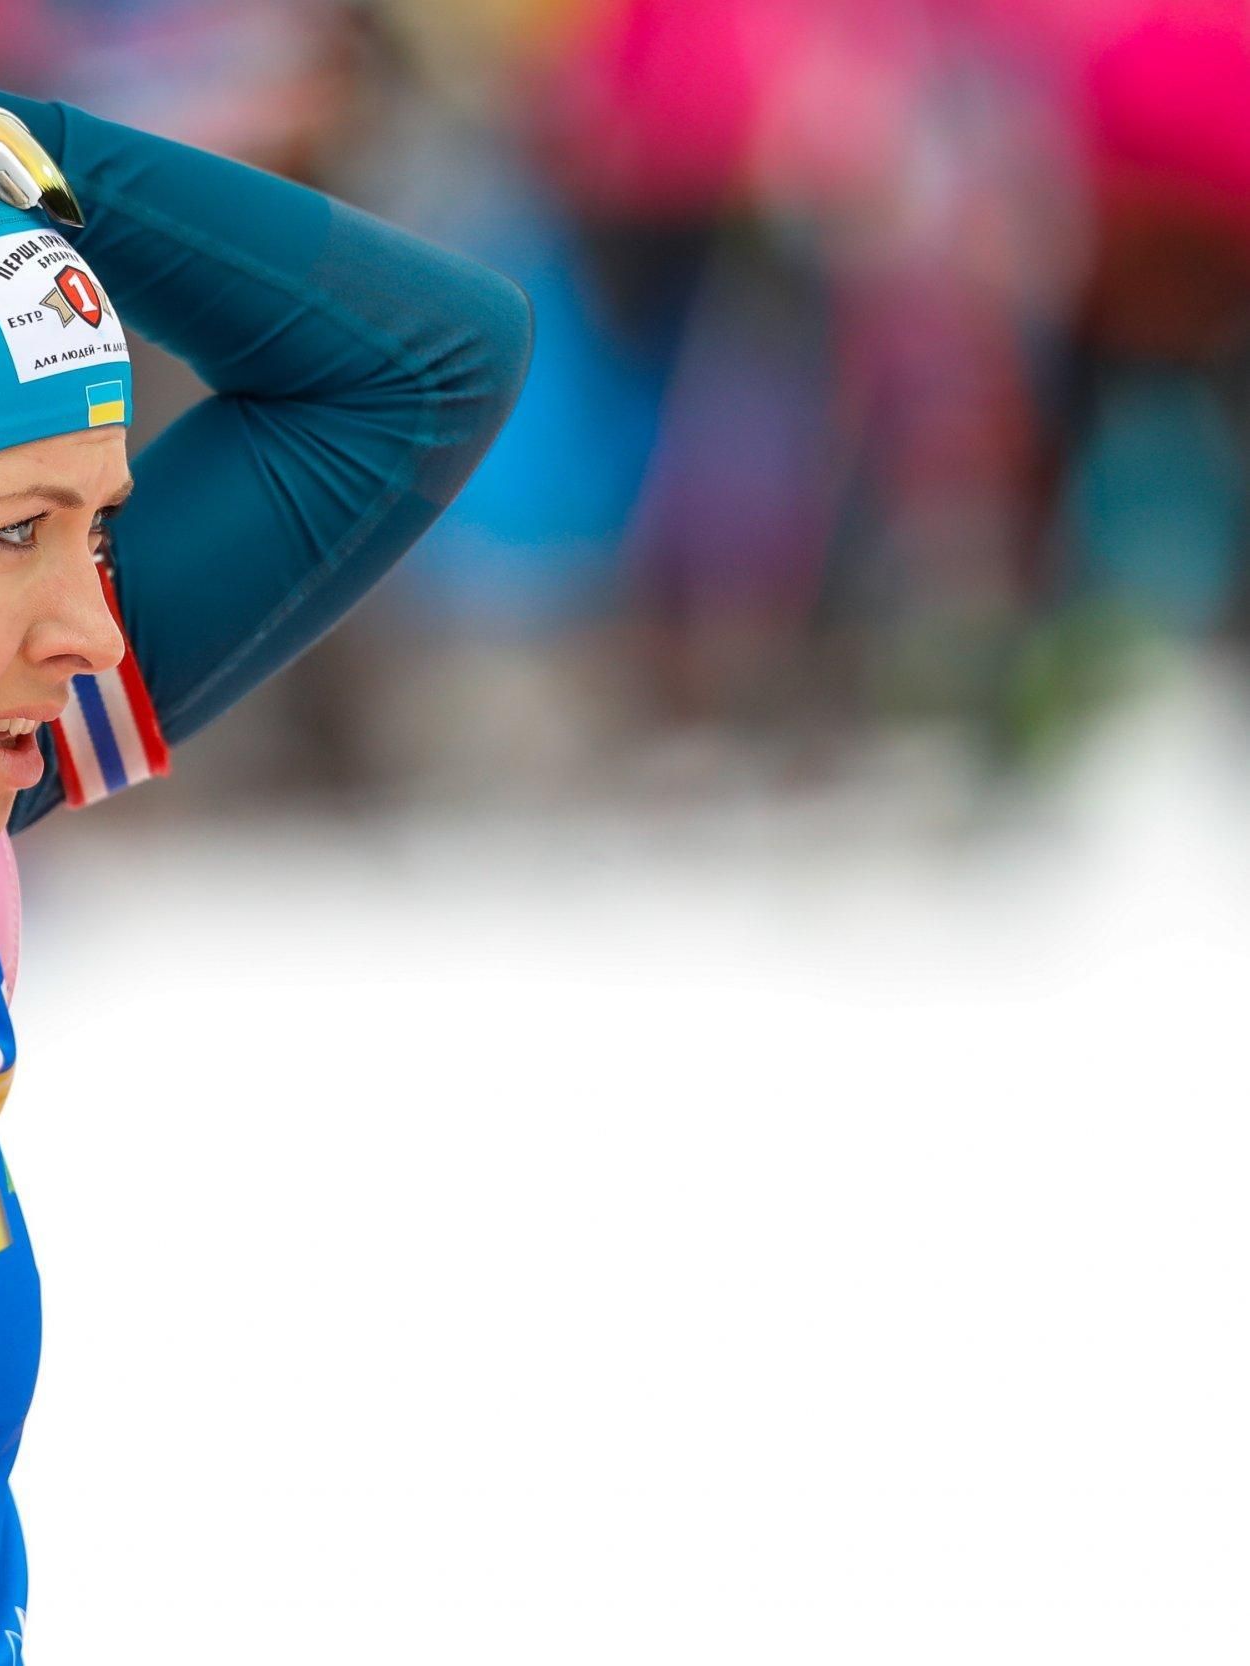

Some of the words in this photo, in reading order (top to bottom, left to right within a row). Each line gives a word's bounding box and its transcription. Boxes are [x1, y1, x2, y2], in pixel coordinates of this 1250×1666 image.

[68, 273, 98, 313] 1
[34, 354, 58, 370] ДЛЯ
[61, 344, 95, 361] ЛЮДЕЙ
